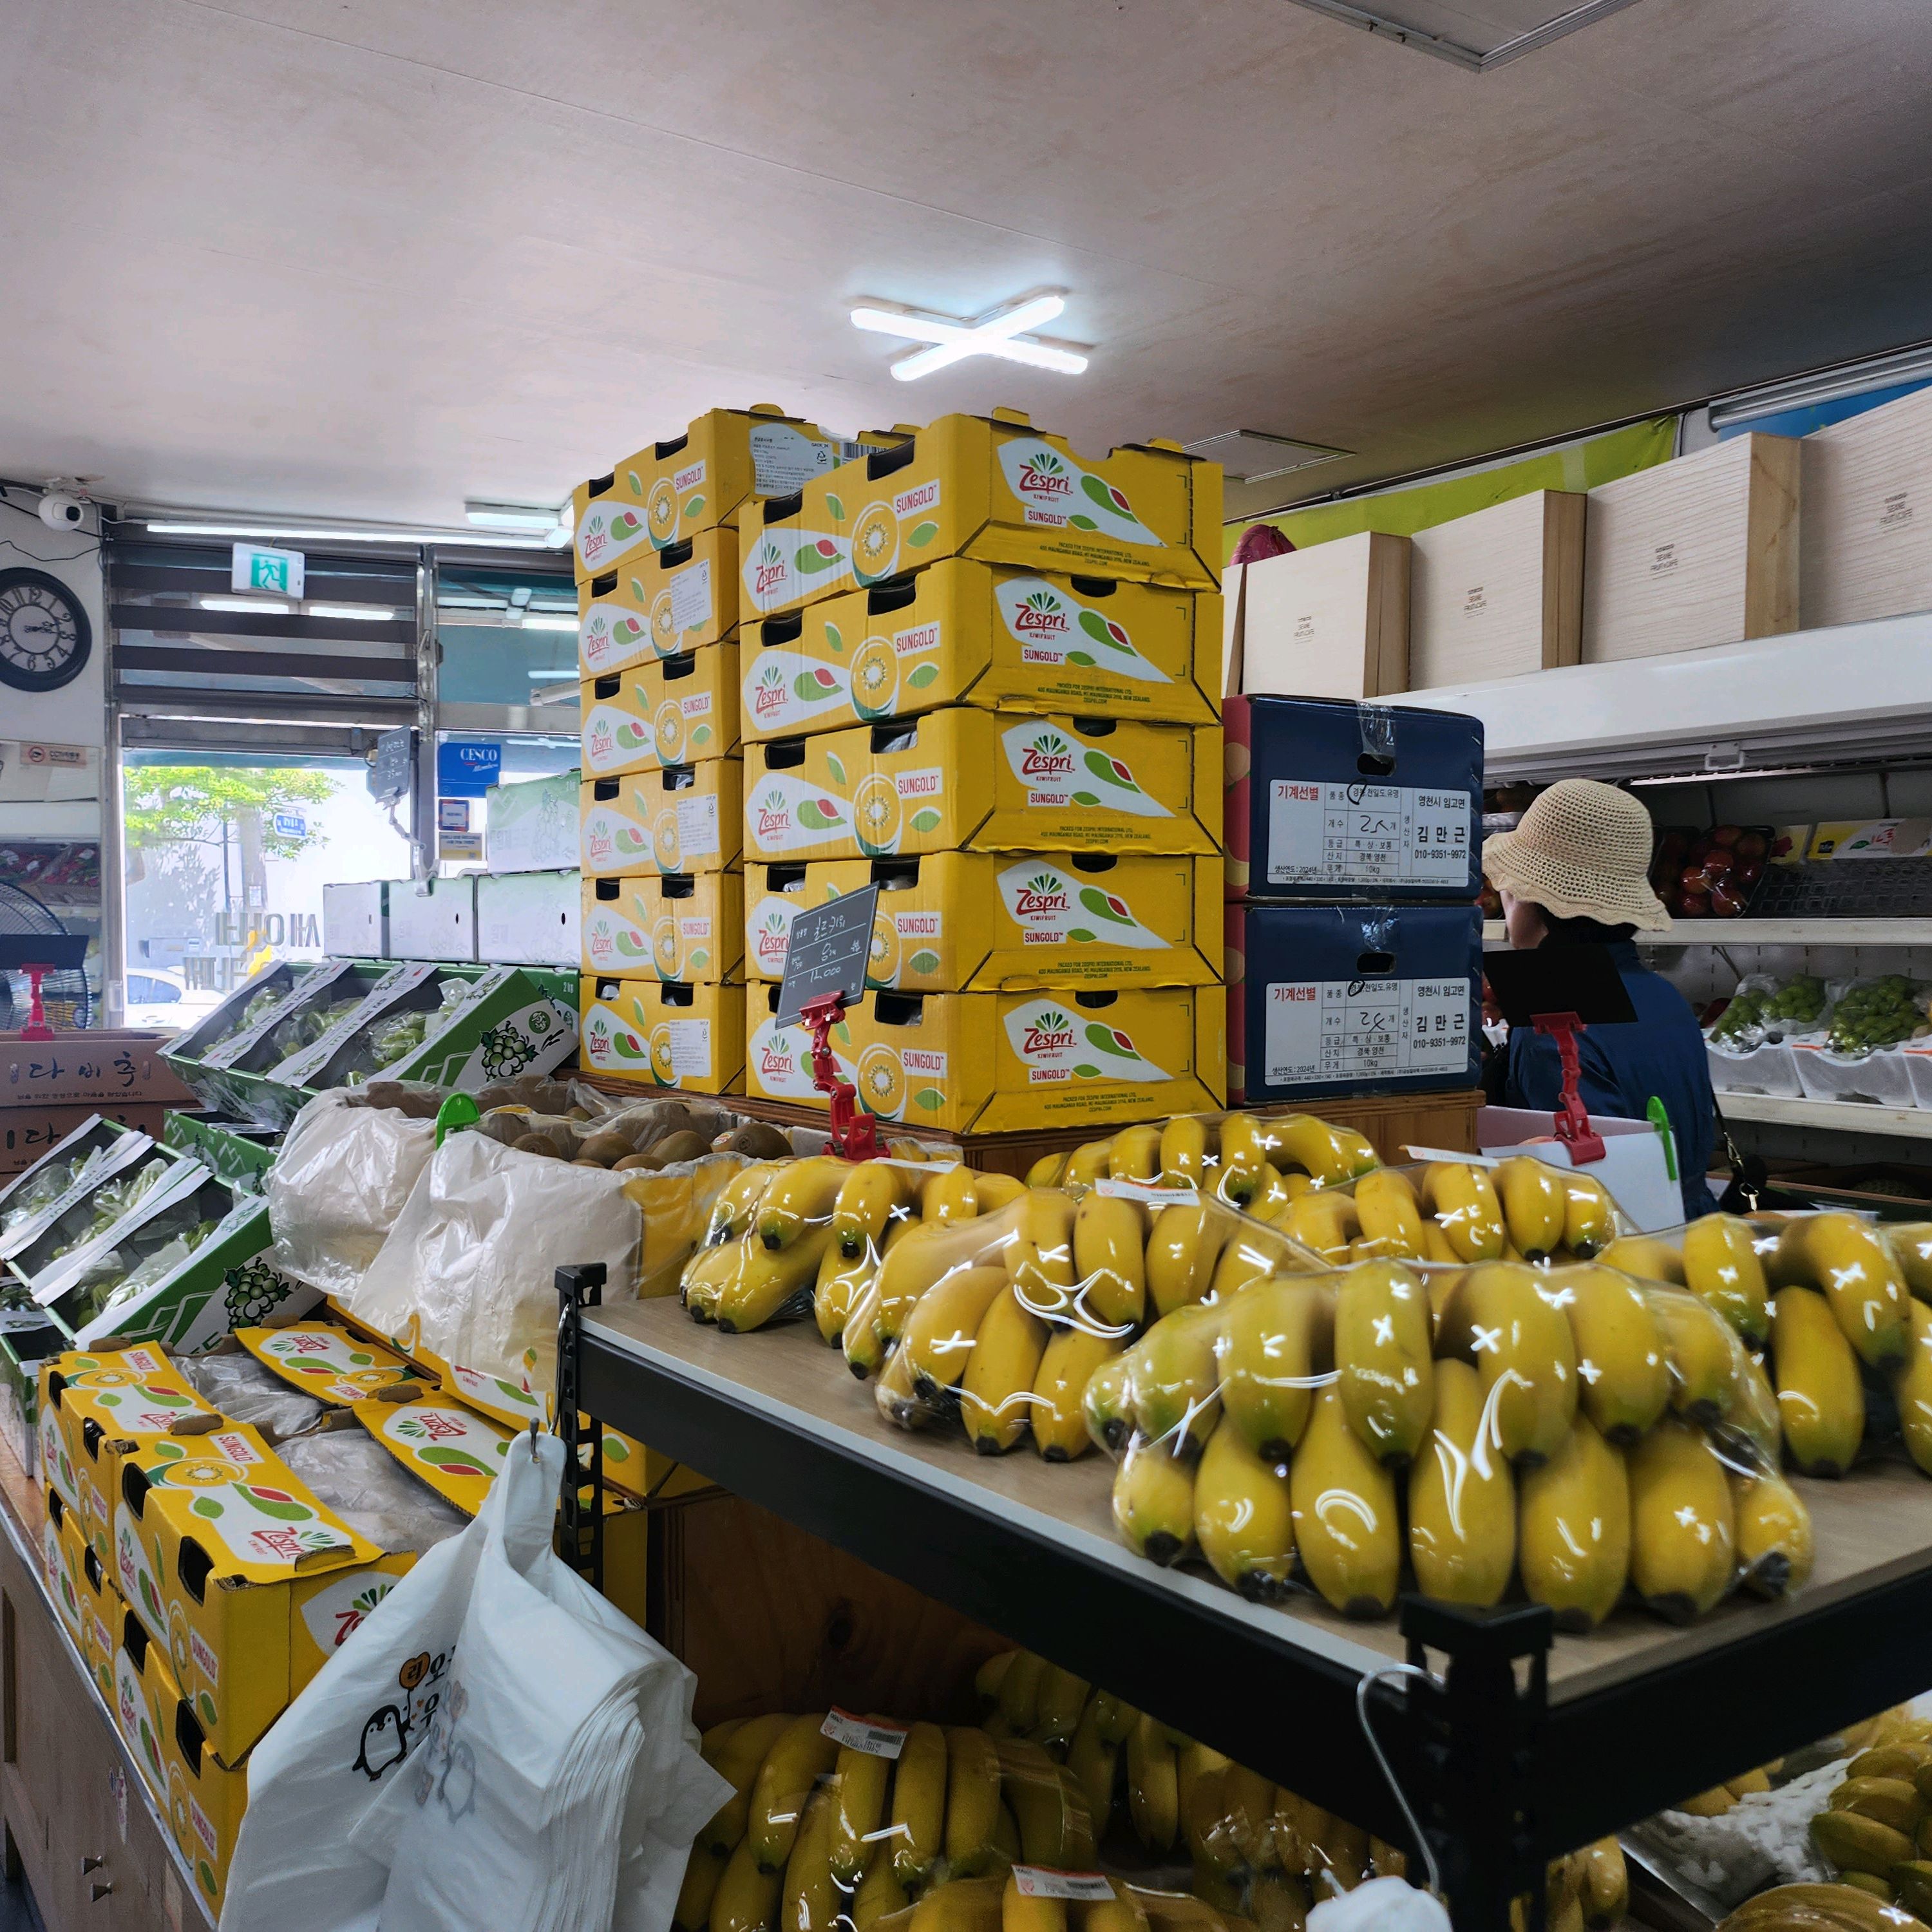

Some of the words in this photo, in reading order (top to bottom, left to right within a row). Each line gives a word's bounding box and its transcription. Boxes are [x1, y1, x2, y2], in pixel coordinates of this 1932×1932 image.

[1019, 464, 1072, 495] Zespri
[1034, 494, 1059, 503] KIWIFRUIT
[756, 561, 787, 593] Zspri
[1015, 603, 1068, 633] Zespri
[755, 686, 787, 714] Zespri
[460, 748, 497, 761] CESCO
[1022, 748, 1072, 775] Zespri
[1278, 785, 1319, 800] 기계선별
[1418, 795, 1441, 808] 영천시
[1443, 797, 1464, 809] 임고면
[759, 808, 791, 836] Zespri
[1414, 849, 1466, 860] 010-9351-9972
[1016, 889, 1067, 915] Zespri
[1274, 987, 1316, 1001] 기계선별
[1417, 986, 1441, 996] 영천시
[1443, 985, 1464, 996] 임고면
[1023, 1028, 1074, 1054] Zespri
[1413, 1036, 1465, 1049] 010-9351-9972
[761, 1047, 793, 1075] Zespri
